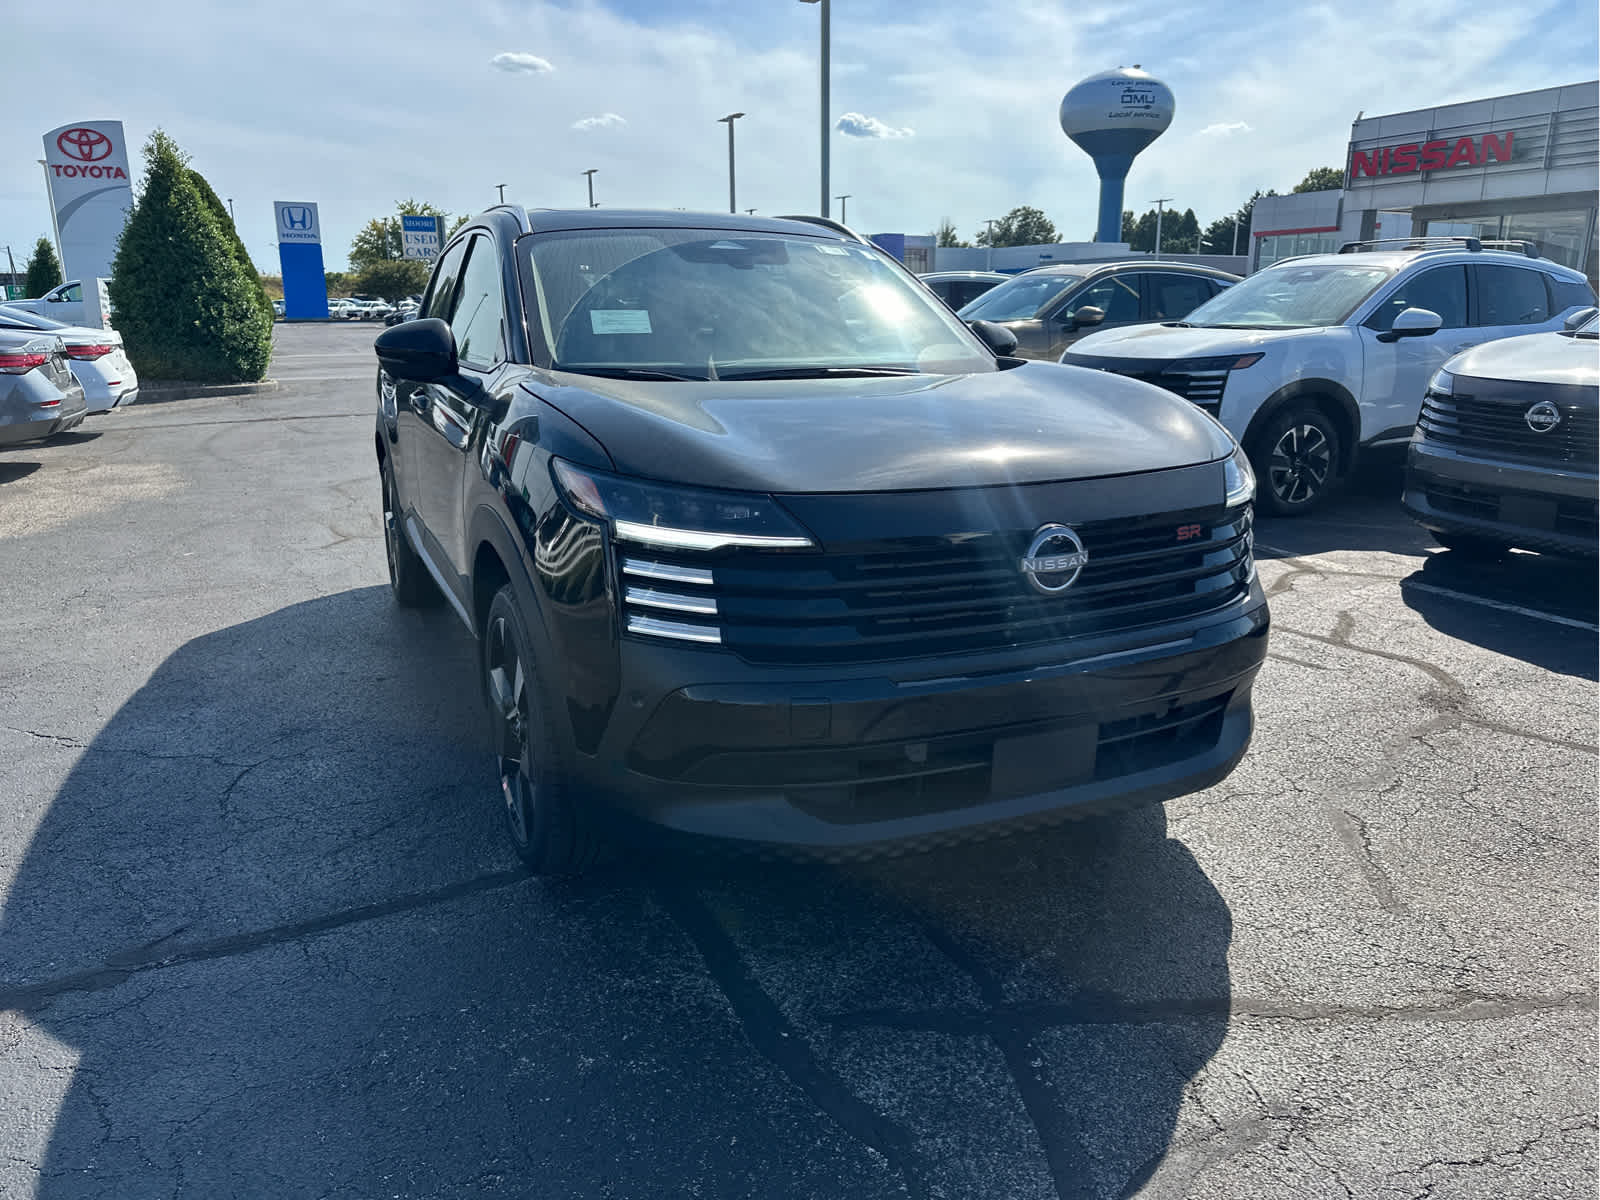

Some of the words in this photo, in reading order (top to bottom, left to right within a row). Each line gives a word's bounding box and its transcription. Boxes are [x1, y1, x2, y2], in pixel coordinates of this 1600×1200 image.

[1120, 94, 1156, 104] OMU
[1351, 132, 1515, 179] NISSAN
[50, 164, 127, 179] TOYOTA
[405, 233, 438, 244] USED
[405, 247, 439, 257] CARS
[1176, 524, 1202, 541] SR
[1022, 551, 1089, 572] NISSAN
